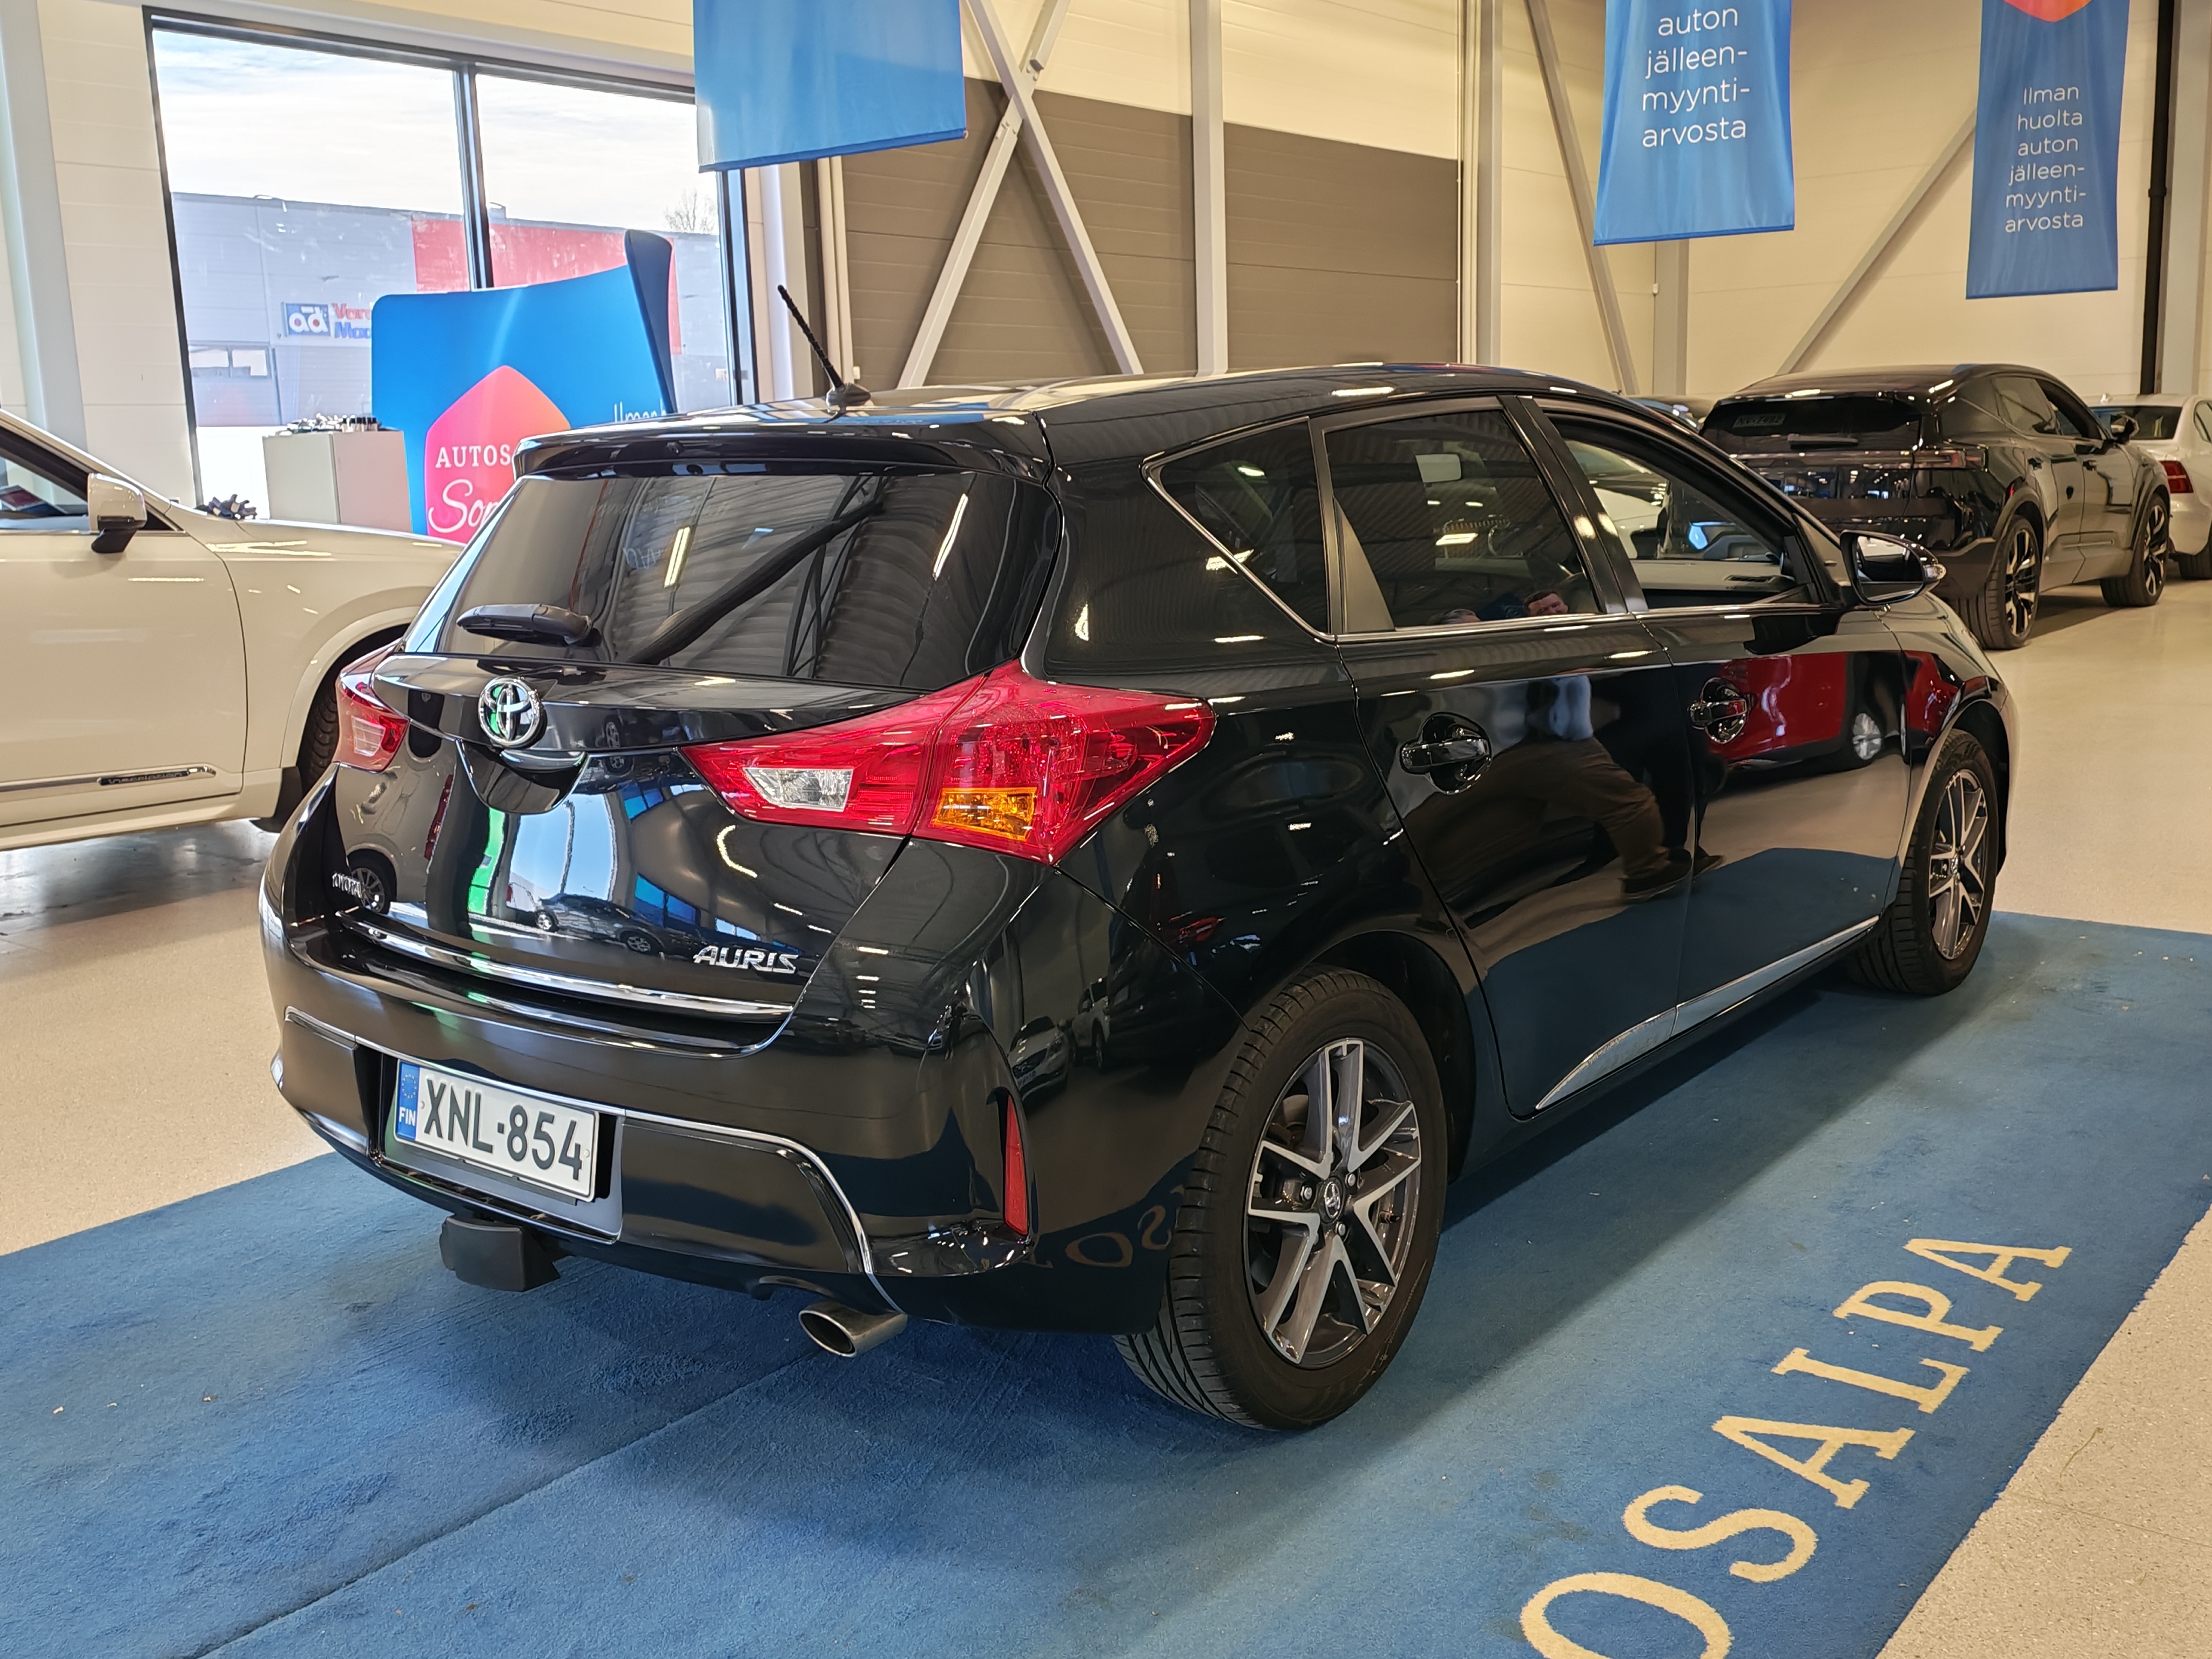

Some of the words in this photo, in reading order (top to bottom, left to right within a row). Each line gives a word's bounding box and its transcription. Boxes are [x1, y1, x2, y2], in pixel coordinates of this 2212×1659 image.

[1657, 8, 1738, 36] auton
[1644, 45, 1748, 79] jälleen-
[1642, 77, 1751, 114] myynti-
[2023, 86, 2080, 105] Ilman
[1642, 117, 1746, 148] arvosta
[2017, 109, 2083, 132] huolta
[2018, 137, 2079, 157] auton
[2008, 163, 2085, 186] jälleen-
[2005, 185, 2087, 210] myynti-
[2005, 211, 2083, 233] arvosta
[435, 444, 511, 469] AUTOS
[693, 945, 799, 974] AURIS
[399, 1107, 416, 1127] FIN
[423, 1078, 583, 1182] XNL-854
